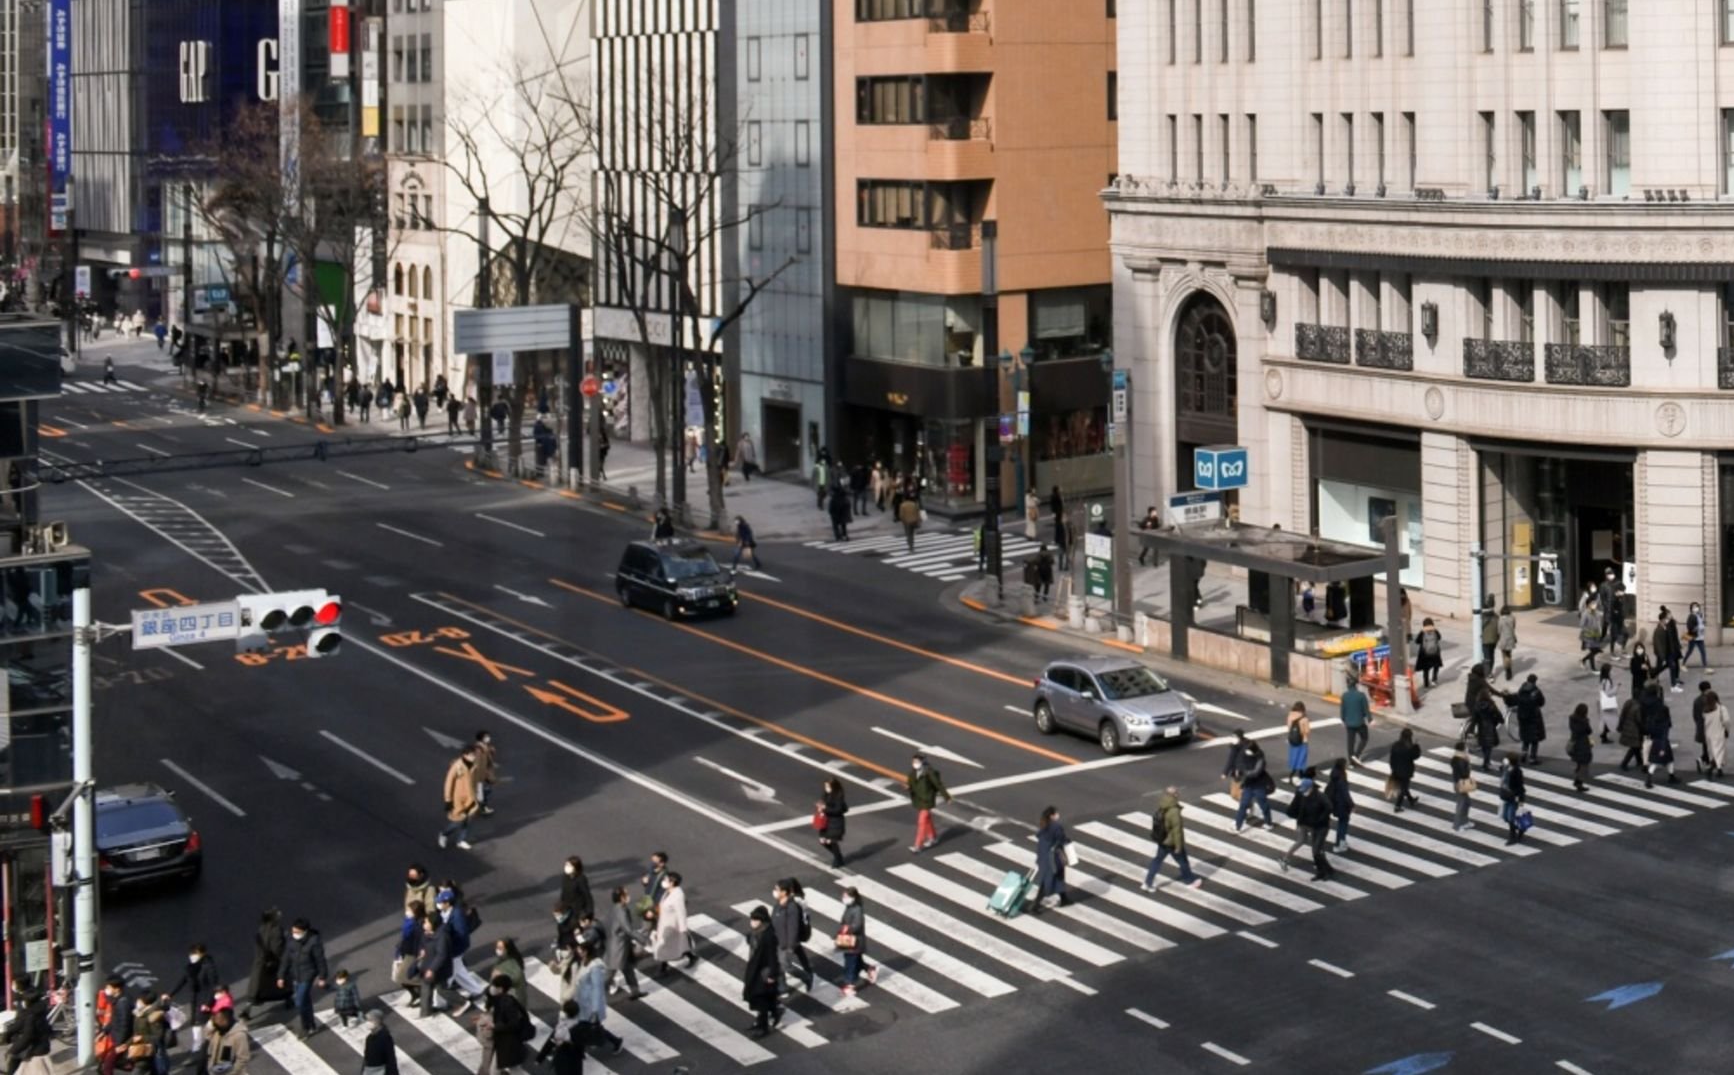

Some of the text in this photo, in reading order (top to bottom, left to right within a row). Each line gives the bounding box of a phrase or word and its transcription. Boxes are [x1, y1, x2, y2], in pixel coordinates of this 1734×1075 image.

[179, 40, 208, 103] GAP
[142, 612, 233, 636] 銀座四丁目
